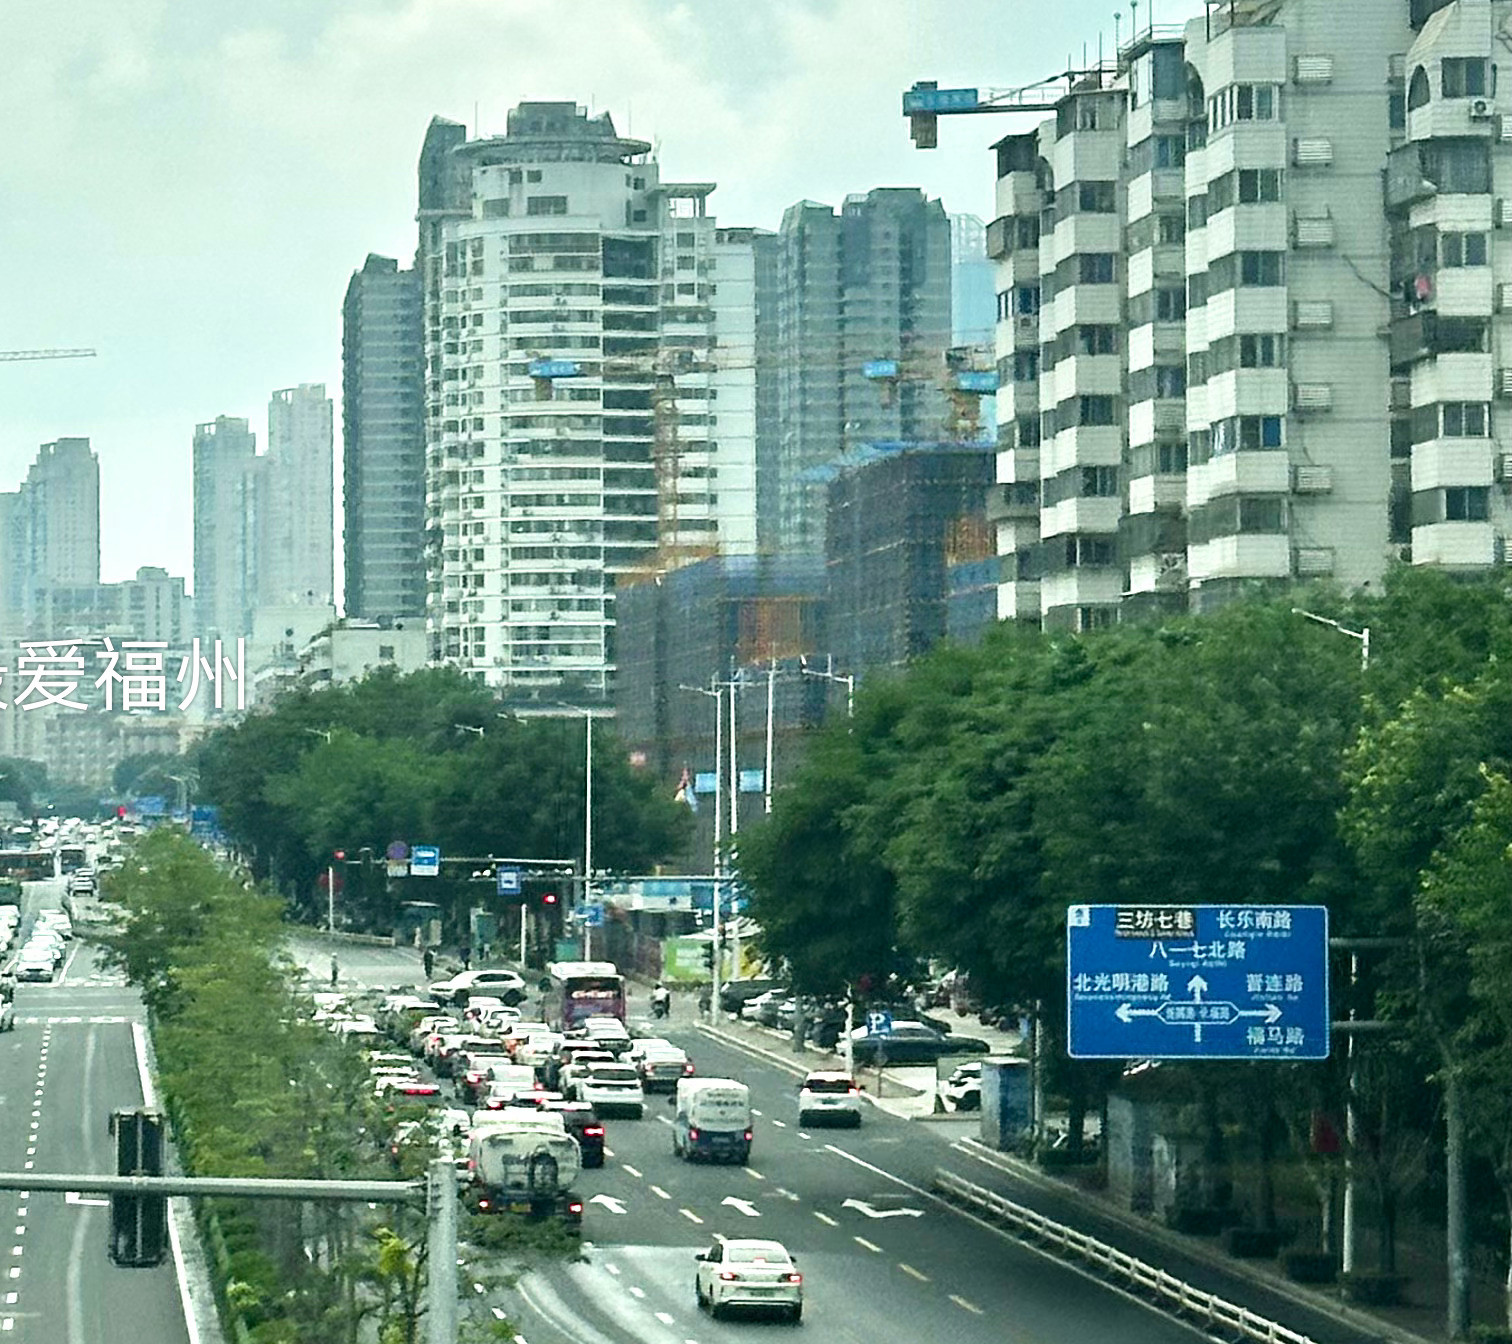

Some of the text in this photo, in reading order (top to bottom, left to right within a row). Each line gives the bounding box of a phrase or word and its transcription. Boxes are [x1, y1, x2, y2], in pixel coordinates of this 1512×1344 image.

[1116, 910, 1193, 930] 三坊七巷
[1216, 909, 1293, 930] 长乐南路
[1148, 940, 1247, 960] 八一七北路
[1073, 972, 1169, 993] 北光明港路
[1246, 1026, 1305, 1046] 福马路
